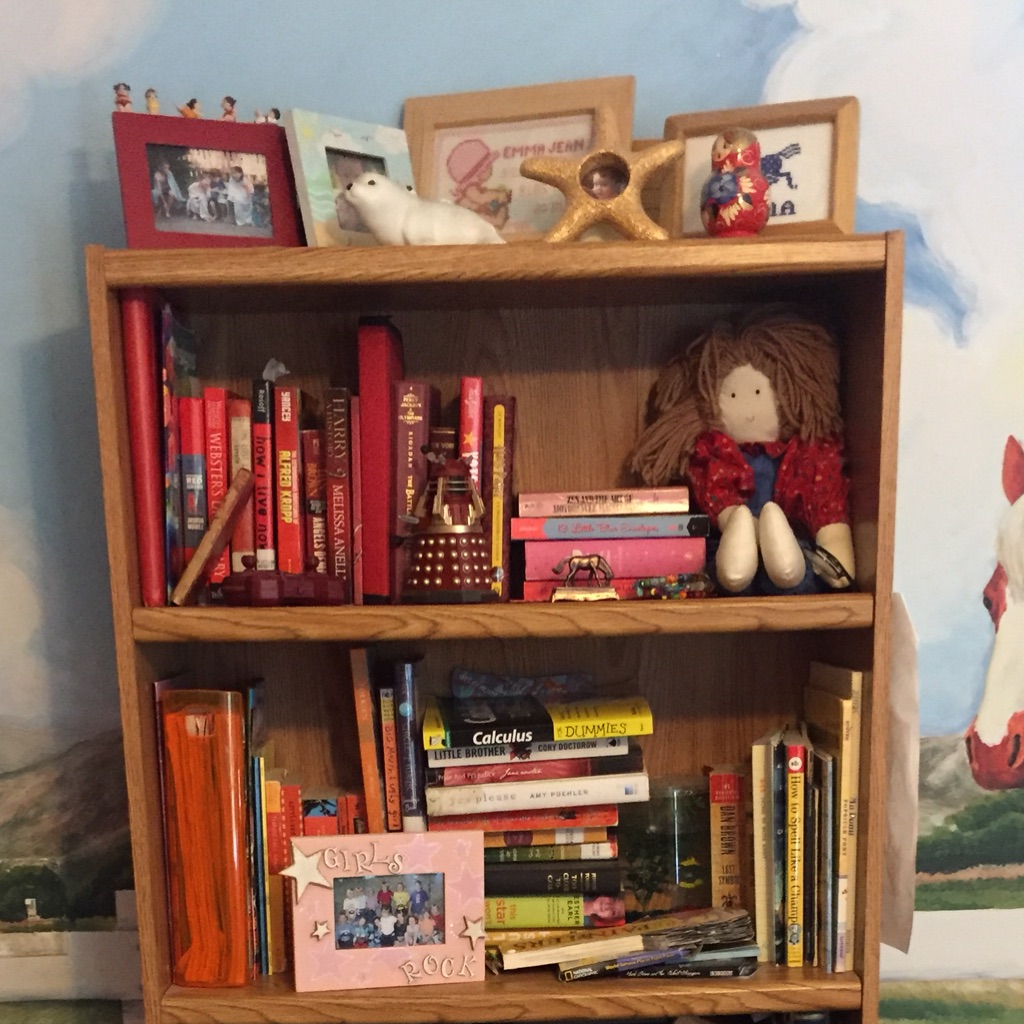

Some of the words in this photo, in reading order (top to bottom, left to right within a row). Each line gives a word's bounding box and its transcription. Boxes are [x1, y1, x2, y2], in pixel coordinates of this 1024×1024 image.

[472, 730, 533, 746] Calculus
[565, 723, 627, 736] DUMMIES
[538, 744, 556, 752] CORY
[558, 741, 597, 751] DOCTOROW
[551, 789, 588, 798] POEHLER
[790, 776, 801, 798] How
[721, 805, 735, 823] DAN
[791, 803, 800, 814] to
[721, 826, 735, 855] BROWN
[789, 817, 801, 845] Spell
[323, 842, 404, 874] GIRLS
[790, 849, 800, 873] Like
[789, 885, 801, 924] Champ
[399, 954, 476, 984] ROCK
